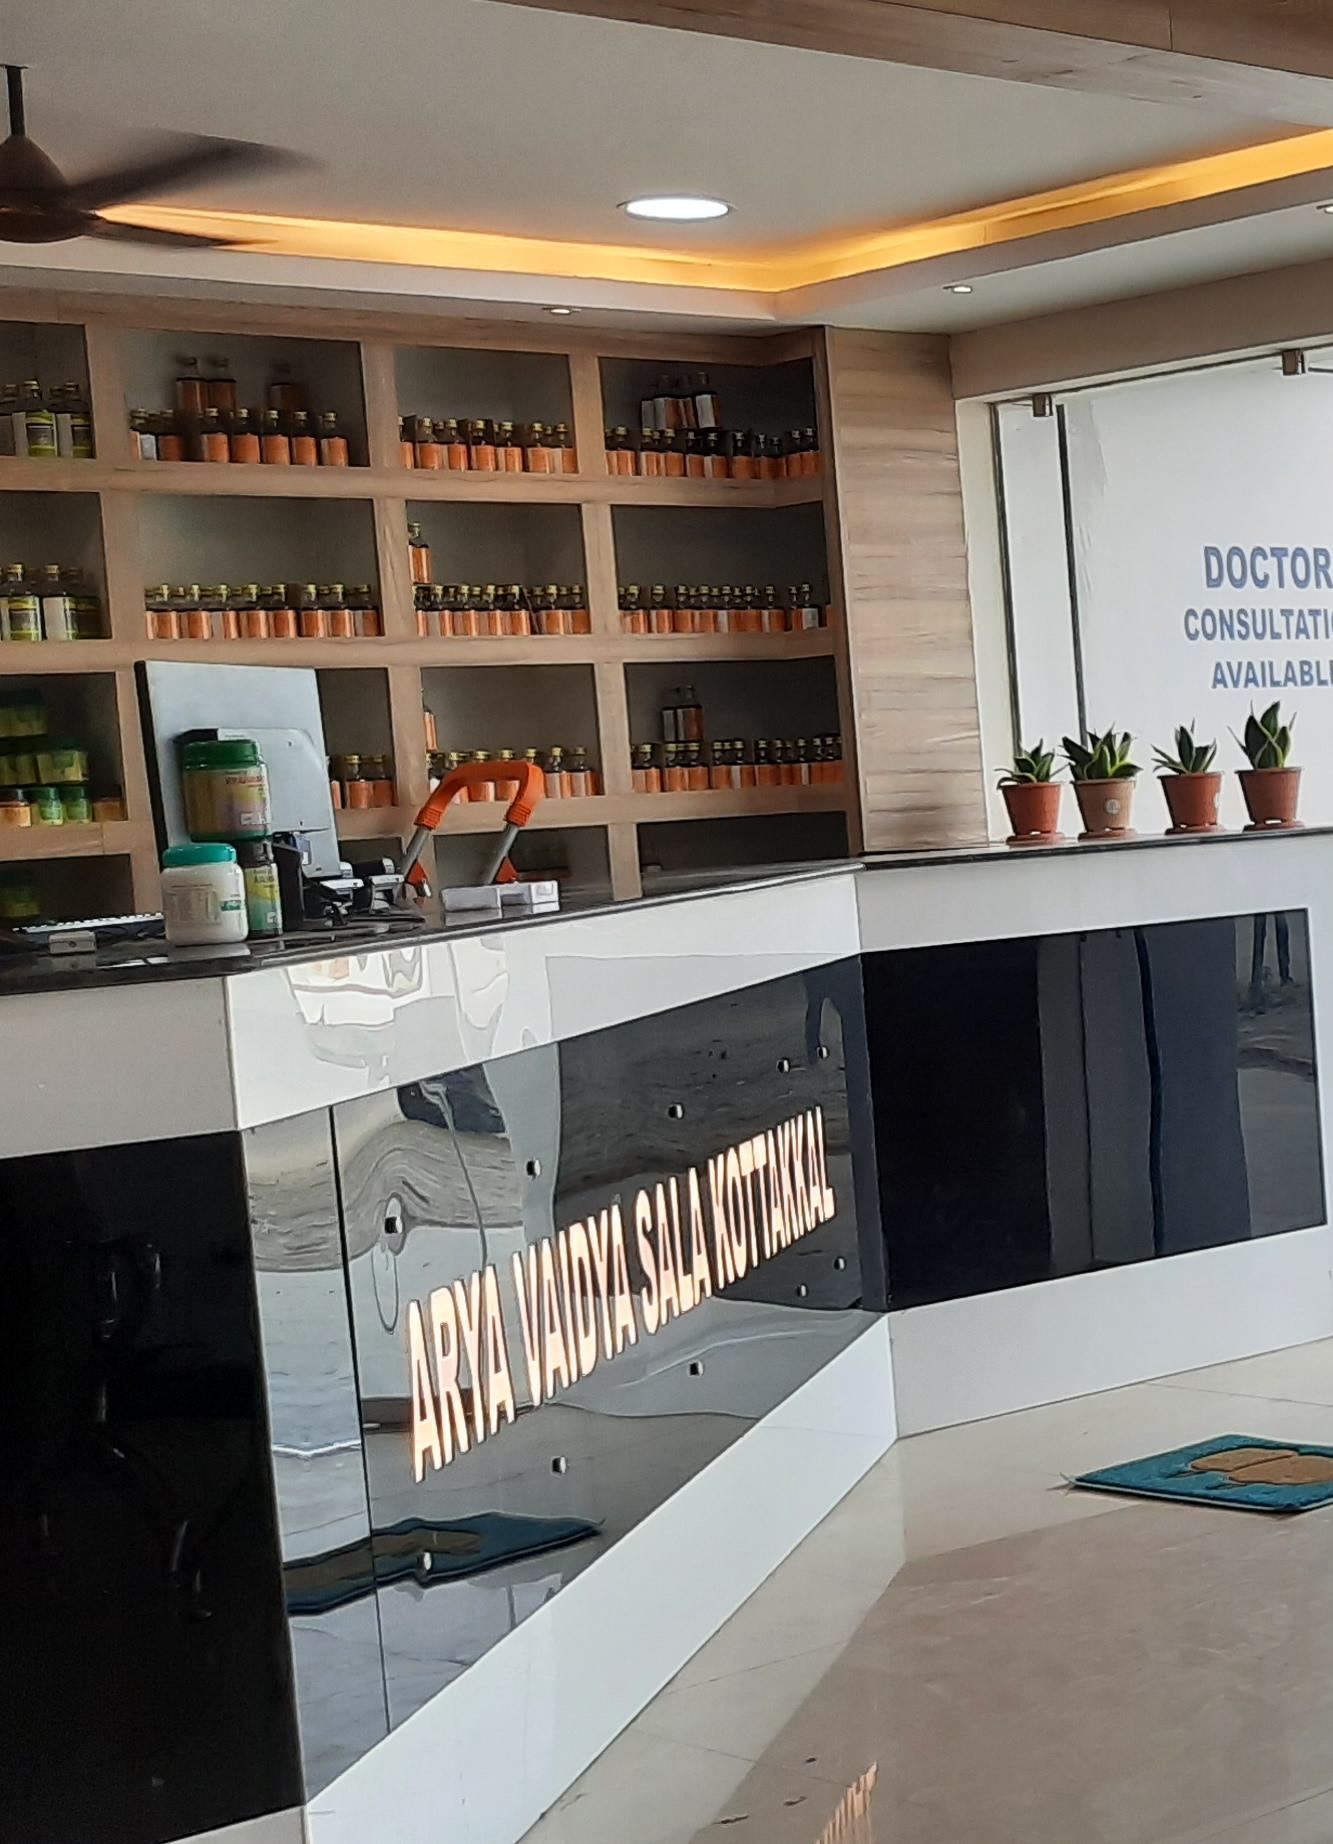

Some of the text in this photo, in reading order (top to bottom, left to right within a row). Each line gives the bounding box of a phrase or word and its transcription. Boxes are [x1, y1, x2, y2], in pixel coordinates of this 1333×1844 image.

[408, 1105, 837, 1484] ARYA VAIDYA SALA KOTTAKKAL
